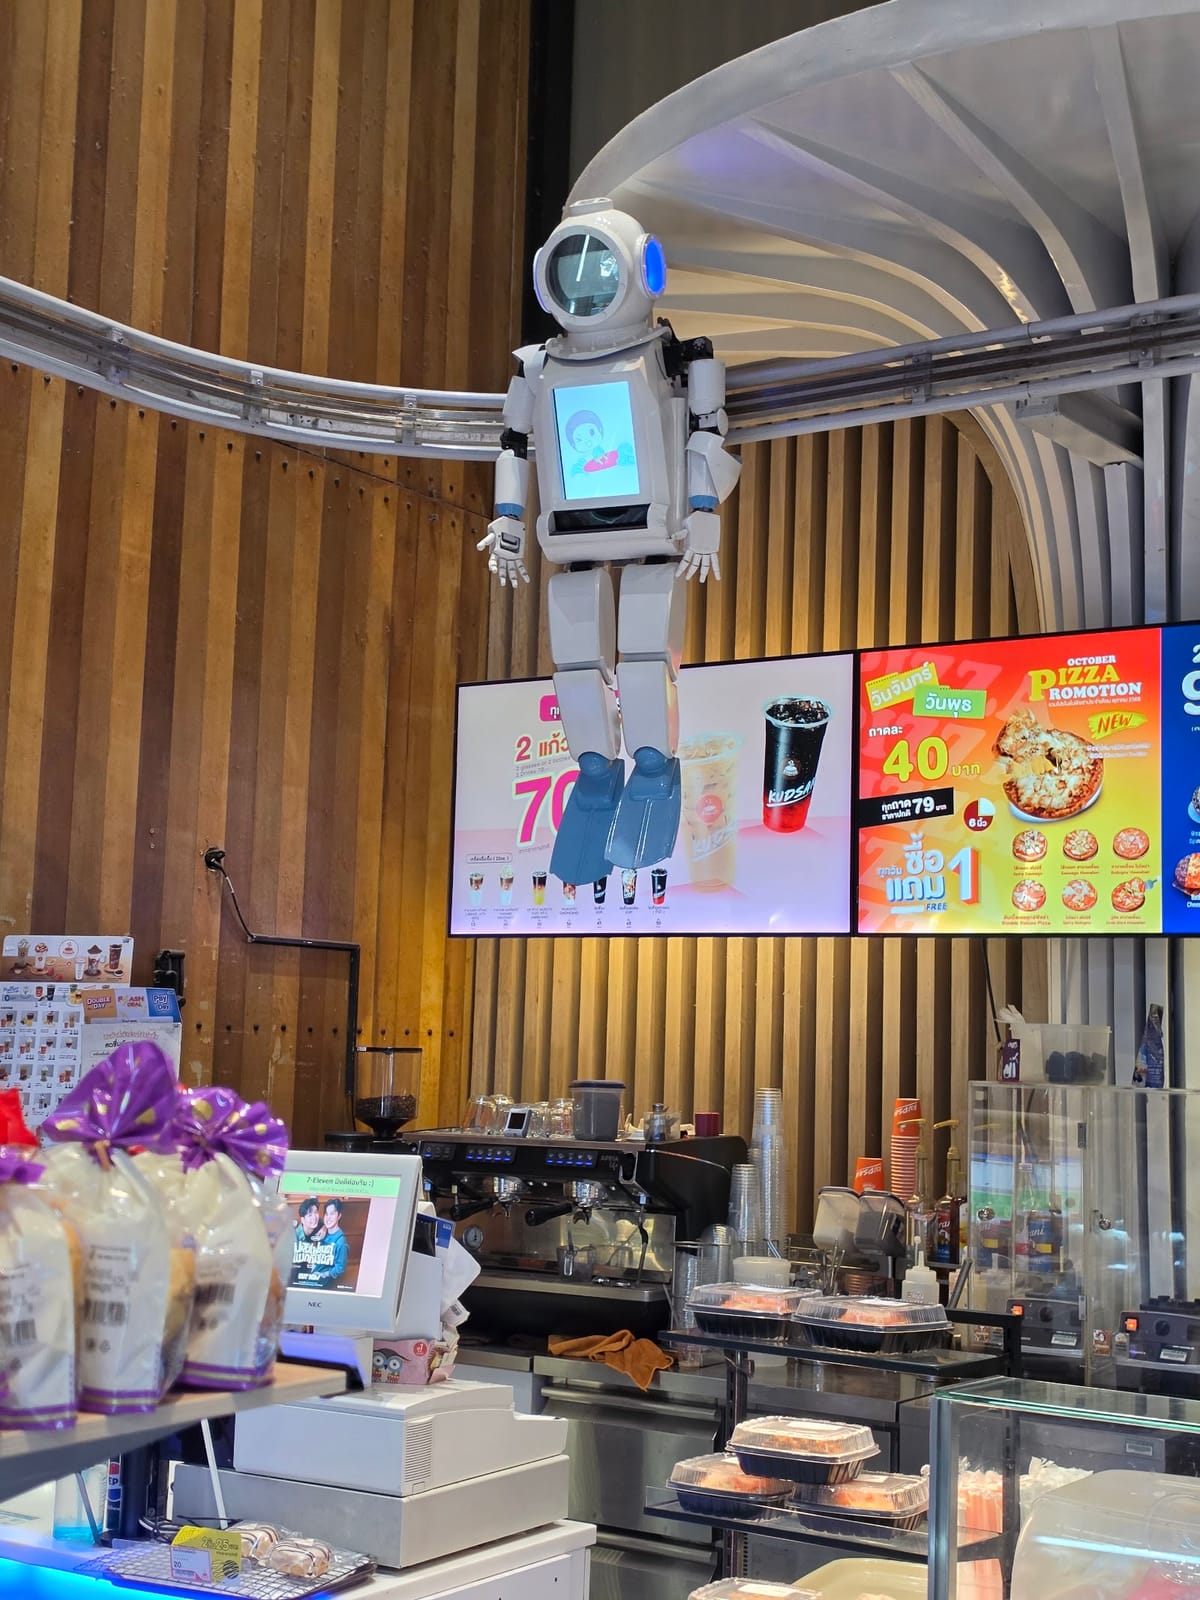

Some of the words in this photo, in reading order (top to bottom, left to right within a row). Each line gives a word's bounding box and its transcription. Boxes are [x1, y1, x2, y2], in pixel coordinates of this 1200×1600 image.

[1067, 655, 1116, 666] OCTOBER
[871, 661, 933, 708] วันจันทร์
[925, 692, 972, 719] วันพุธ
[868, 725, 903, 737] ถาดละ
[1097, 714, 1133, 734] NEW
[515, 736, 531, 762] 2
[883, 736, 949, 782] 40
[952, 764, 981, 776] บาท
[912, 797, 935, 814] 79
[969, 819, 976, 828] 6
[904, 833, 944, 875] ซื้อ
[948, 847, 979, 904] 1
[886, 875, 945, 902] แถม
[926, 903, 947, 911] FREE
[86, 995, 111, 1005] DOUBLE
[153, 993, 168, 1004] Pay
[306, 1176, 334, 1185] 7-Eleven
[215, 1537, 229, 1551] 25
